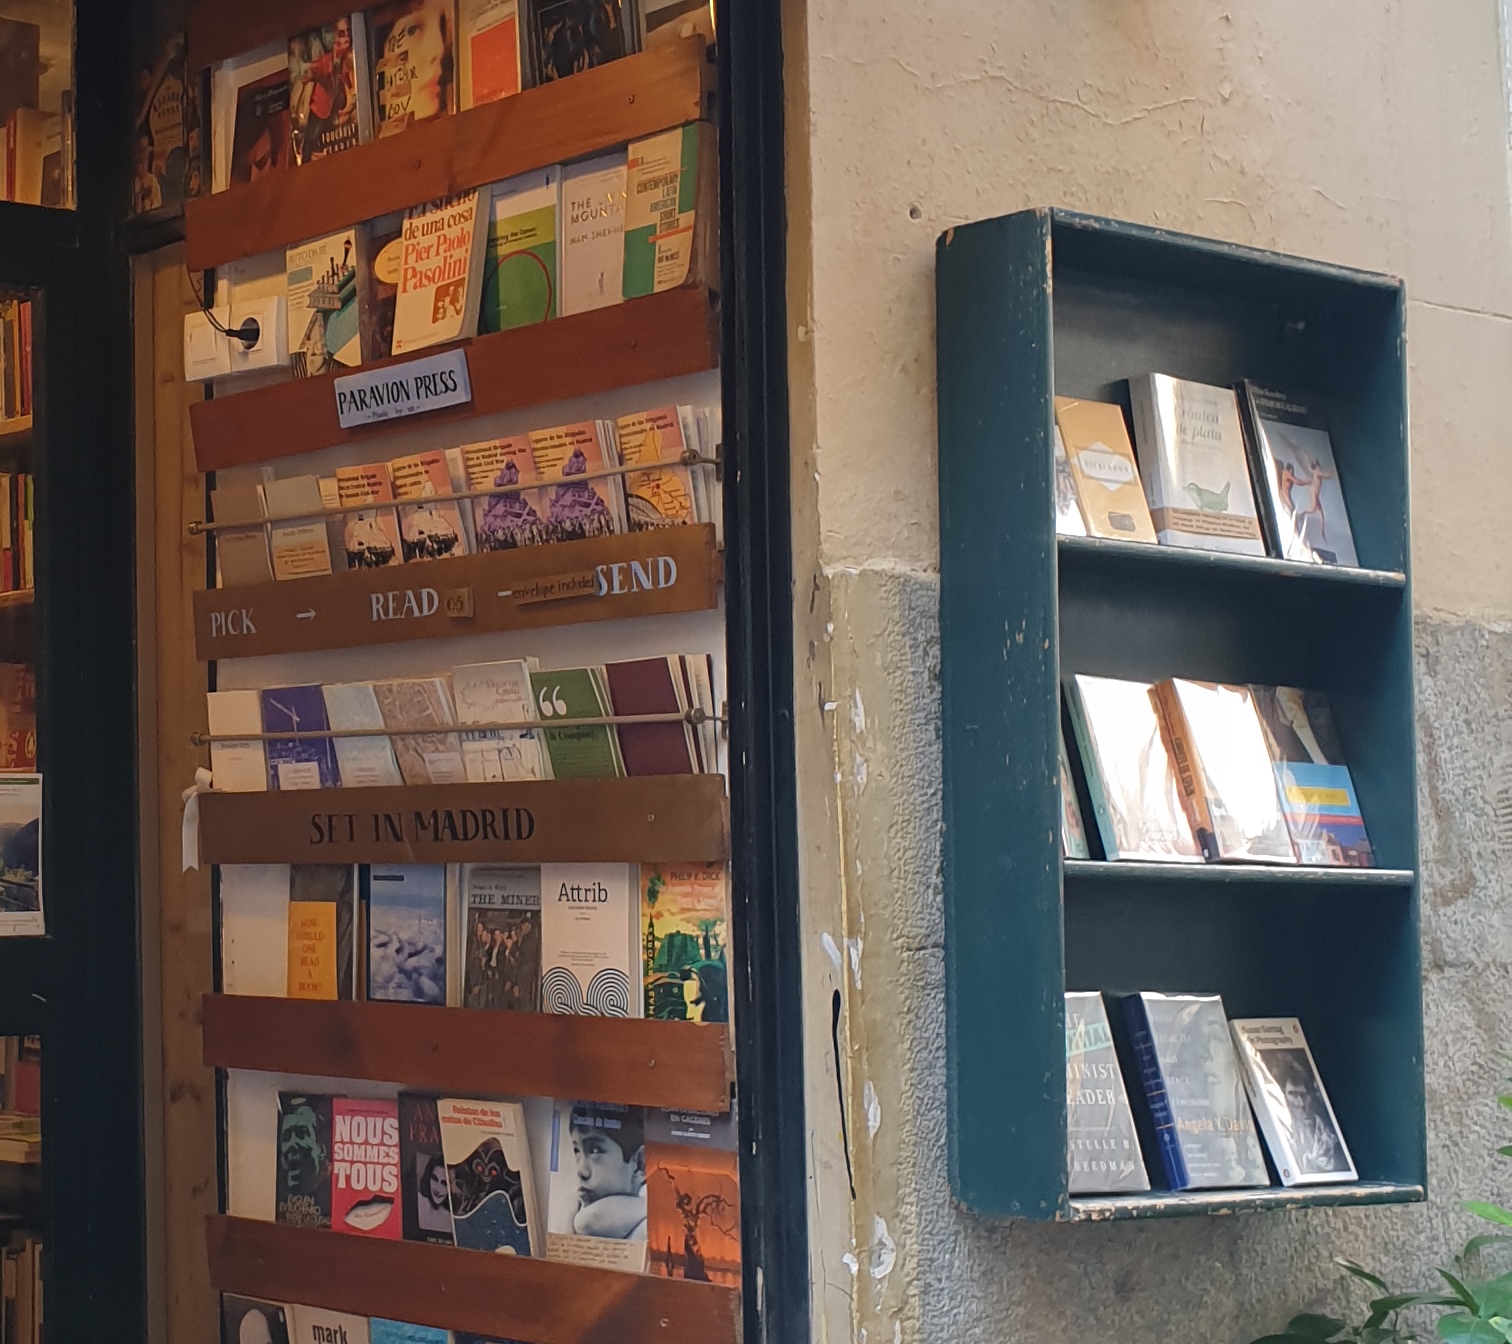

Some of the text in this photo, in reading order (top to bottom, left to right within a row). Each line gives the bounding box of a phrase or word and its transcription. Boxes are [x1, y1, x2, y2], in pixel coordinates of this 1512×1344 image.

[570, 197, 592, 213] THE
[404, 206, 473, 241] de una cosa
[403, 240, 432, 266] Pier
[435, 226, 471, 258] Paolo
[401, 248, 469, 294] Pasolini
[338, 369, 458, 416] PARAVION PRESS
[210, 555, 678, 638] PICK READ envelope included SEND
[308, 806, 536, 847] SET IN MADRID
[669, 871, 721, 882] PHILIP DICK
[471, 892, 496, 906] THE
[336, 1114, 399, 1146] NOUS
[1177, 1116, 1214, 1135] Angela
[334, 1143, 399, 1165] SOMMES
[334, 1162, 398, 1194] TOUS
